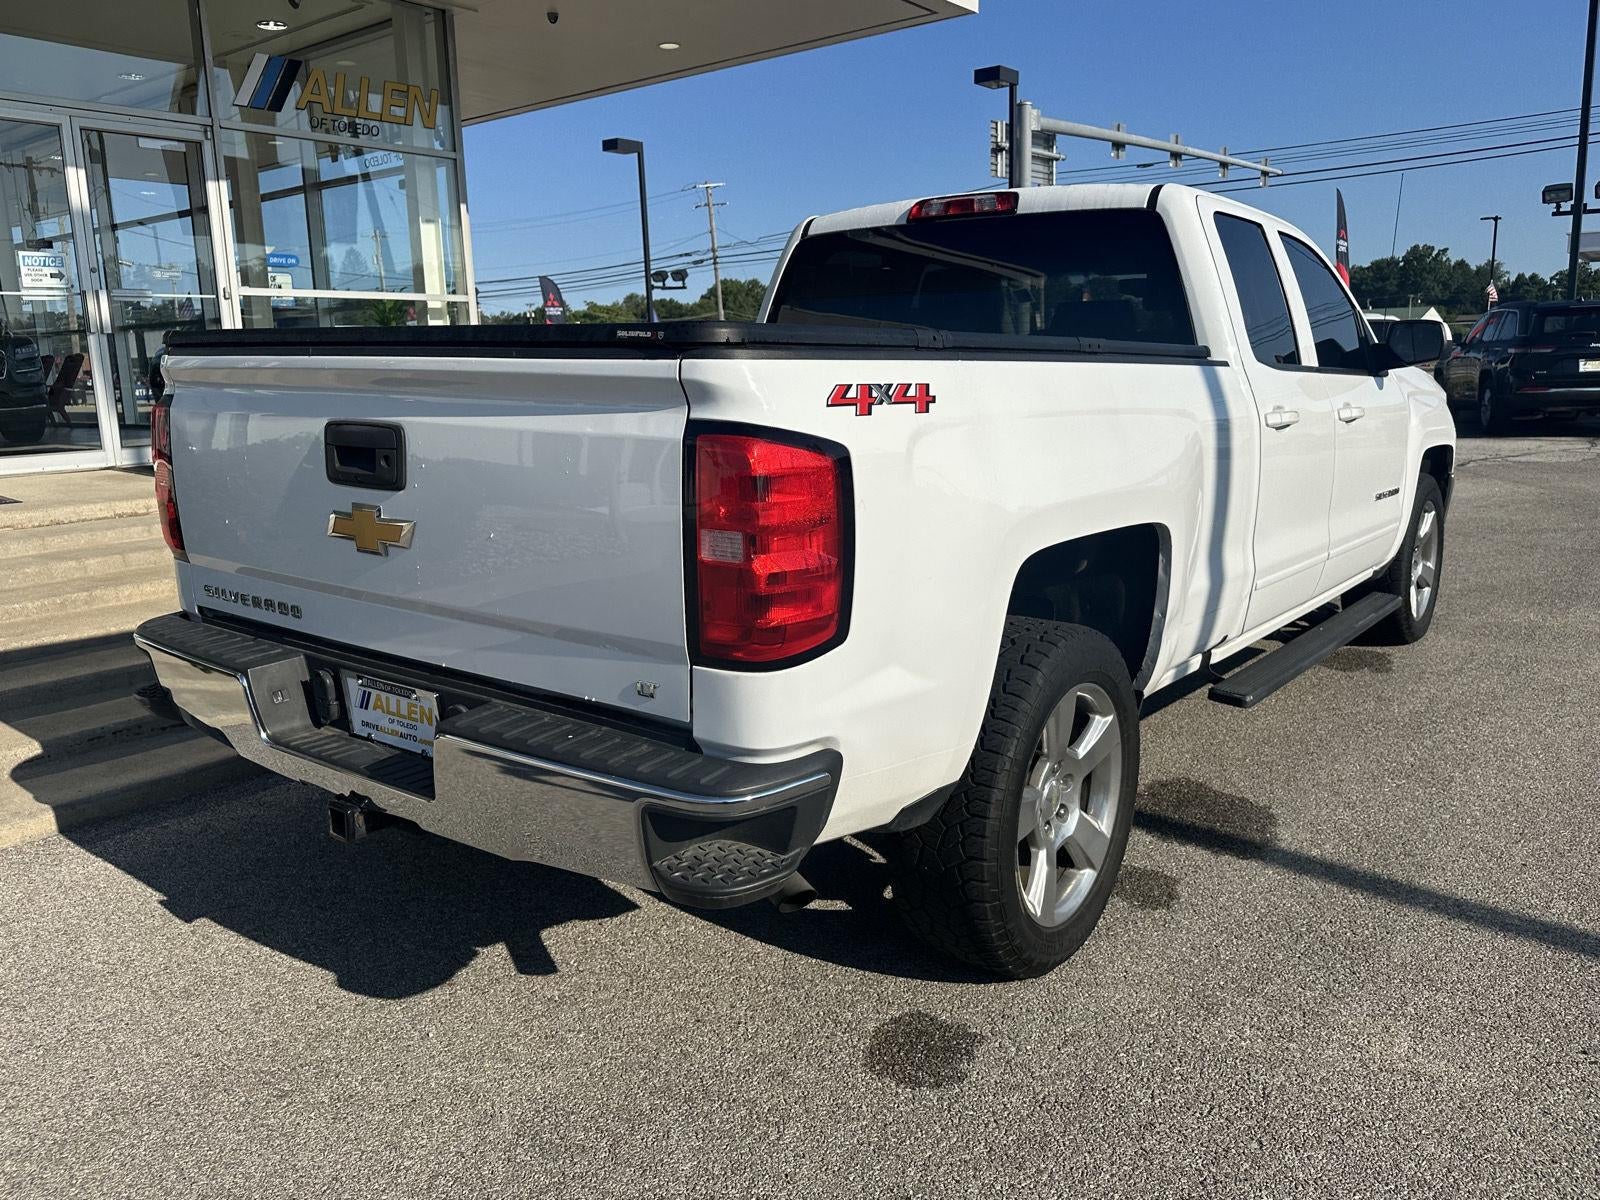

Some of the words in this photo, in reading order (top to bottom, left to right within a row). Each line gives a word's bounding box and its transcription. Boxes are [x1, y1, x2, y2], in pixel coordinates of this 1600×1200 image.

[296, 67, 439, 129] ALLEN
[310, 116, 328, 130] OF
[331, 119, 380, 137] TOLEDO
[24, 256, 62, 267] NOTICE
[204, 584, 303, 619] SILVERADO
[366, 679, 385, 690] ALLEN
[636, 680, 656, 698] LT
[373, 693, 433, 727] ALLEN
[388, 717, 396, 725] OF
[397, 720, 418, 731] TOLEDO
